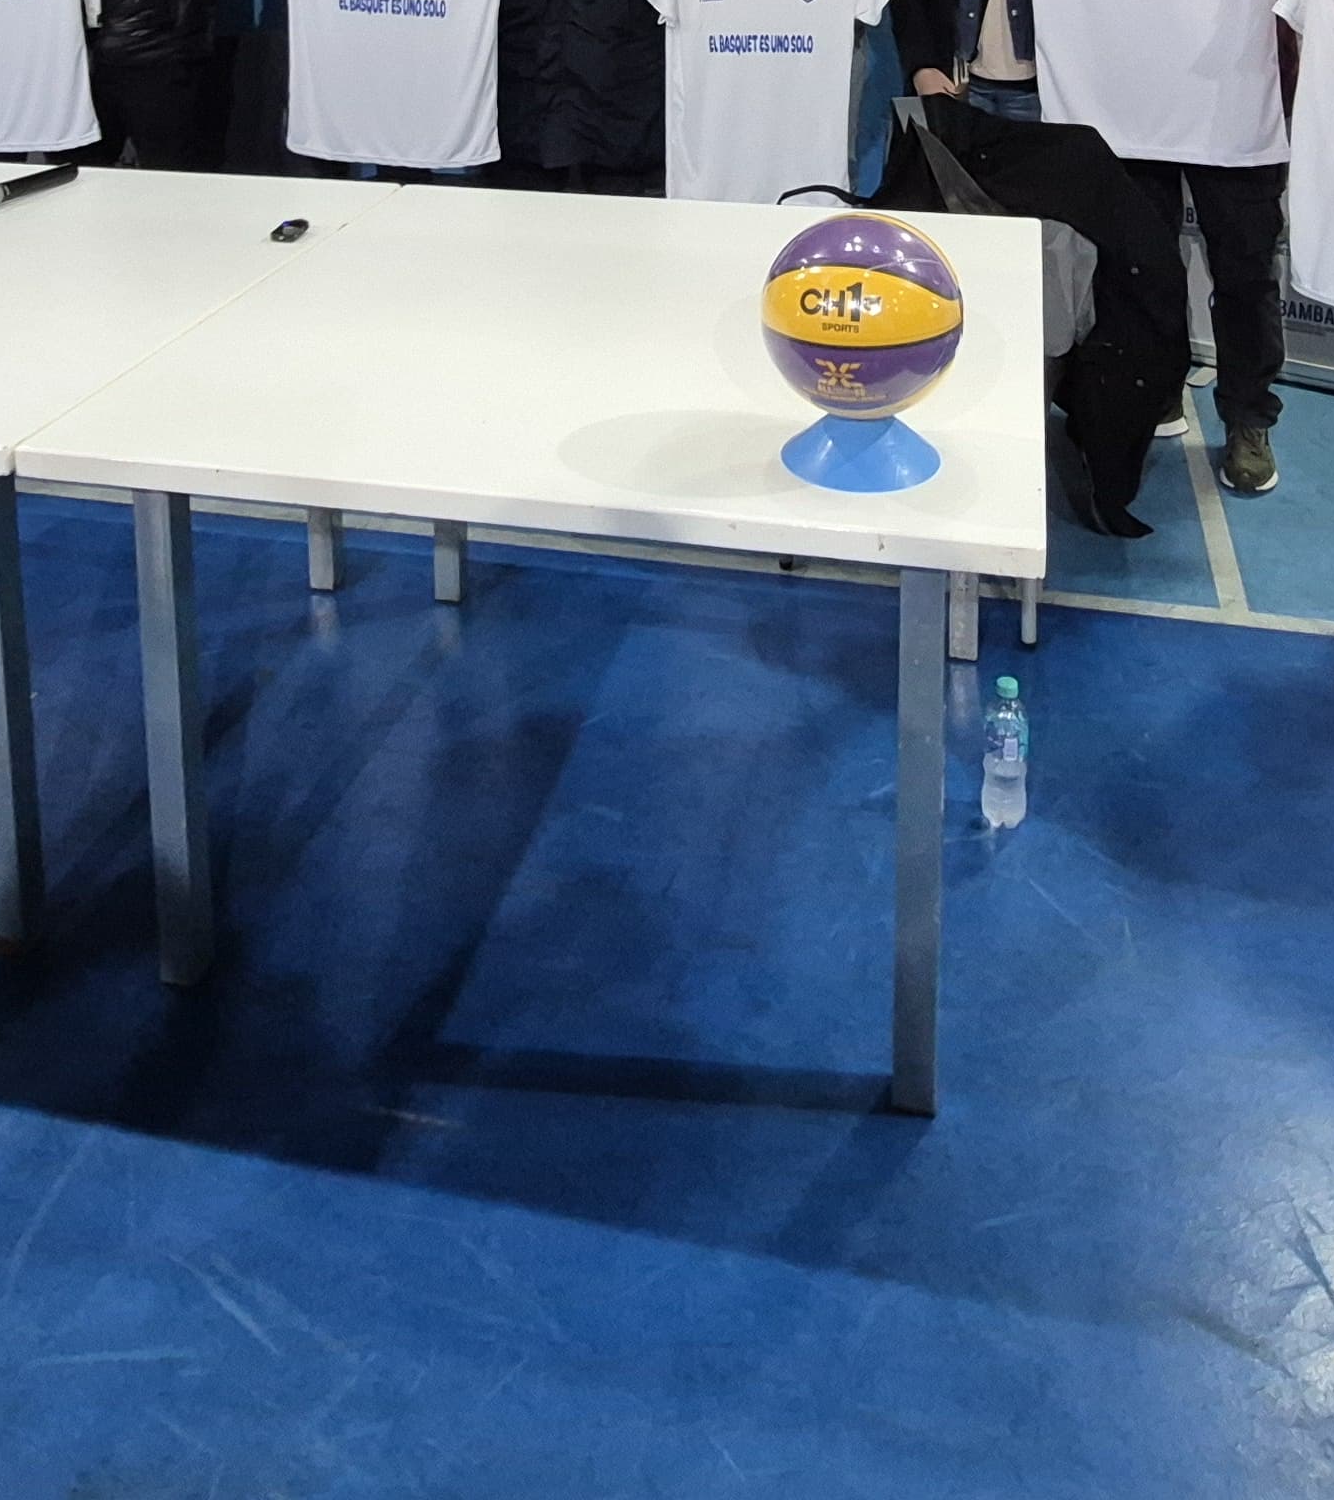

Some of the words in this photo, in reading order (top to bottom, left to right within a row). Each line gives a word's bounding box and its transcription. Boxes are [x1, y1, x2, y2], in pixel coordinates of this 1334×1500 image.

[423, 0, 446, 18] SOLO
[709, 35, 717, 53] EL
[719, 34, 758, 55] BASQUET
[759, 35, 770, 52] ES
[771, 35, 789, 53] UNO
[790, 35, 813, 53] SOLO
[822, 322, 859, 334] SPORTS
